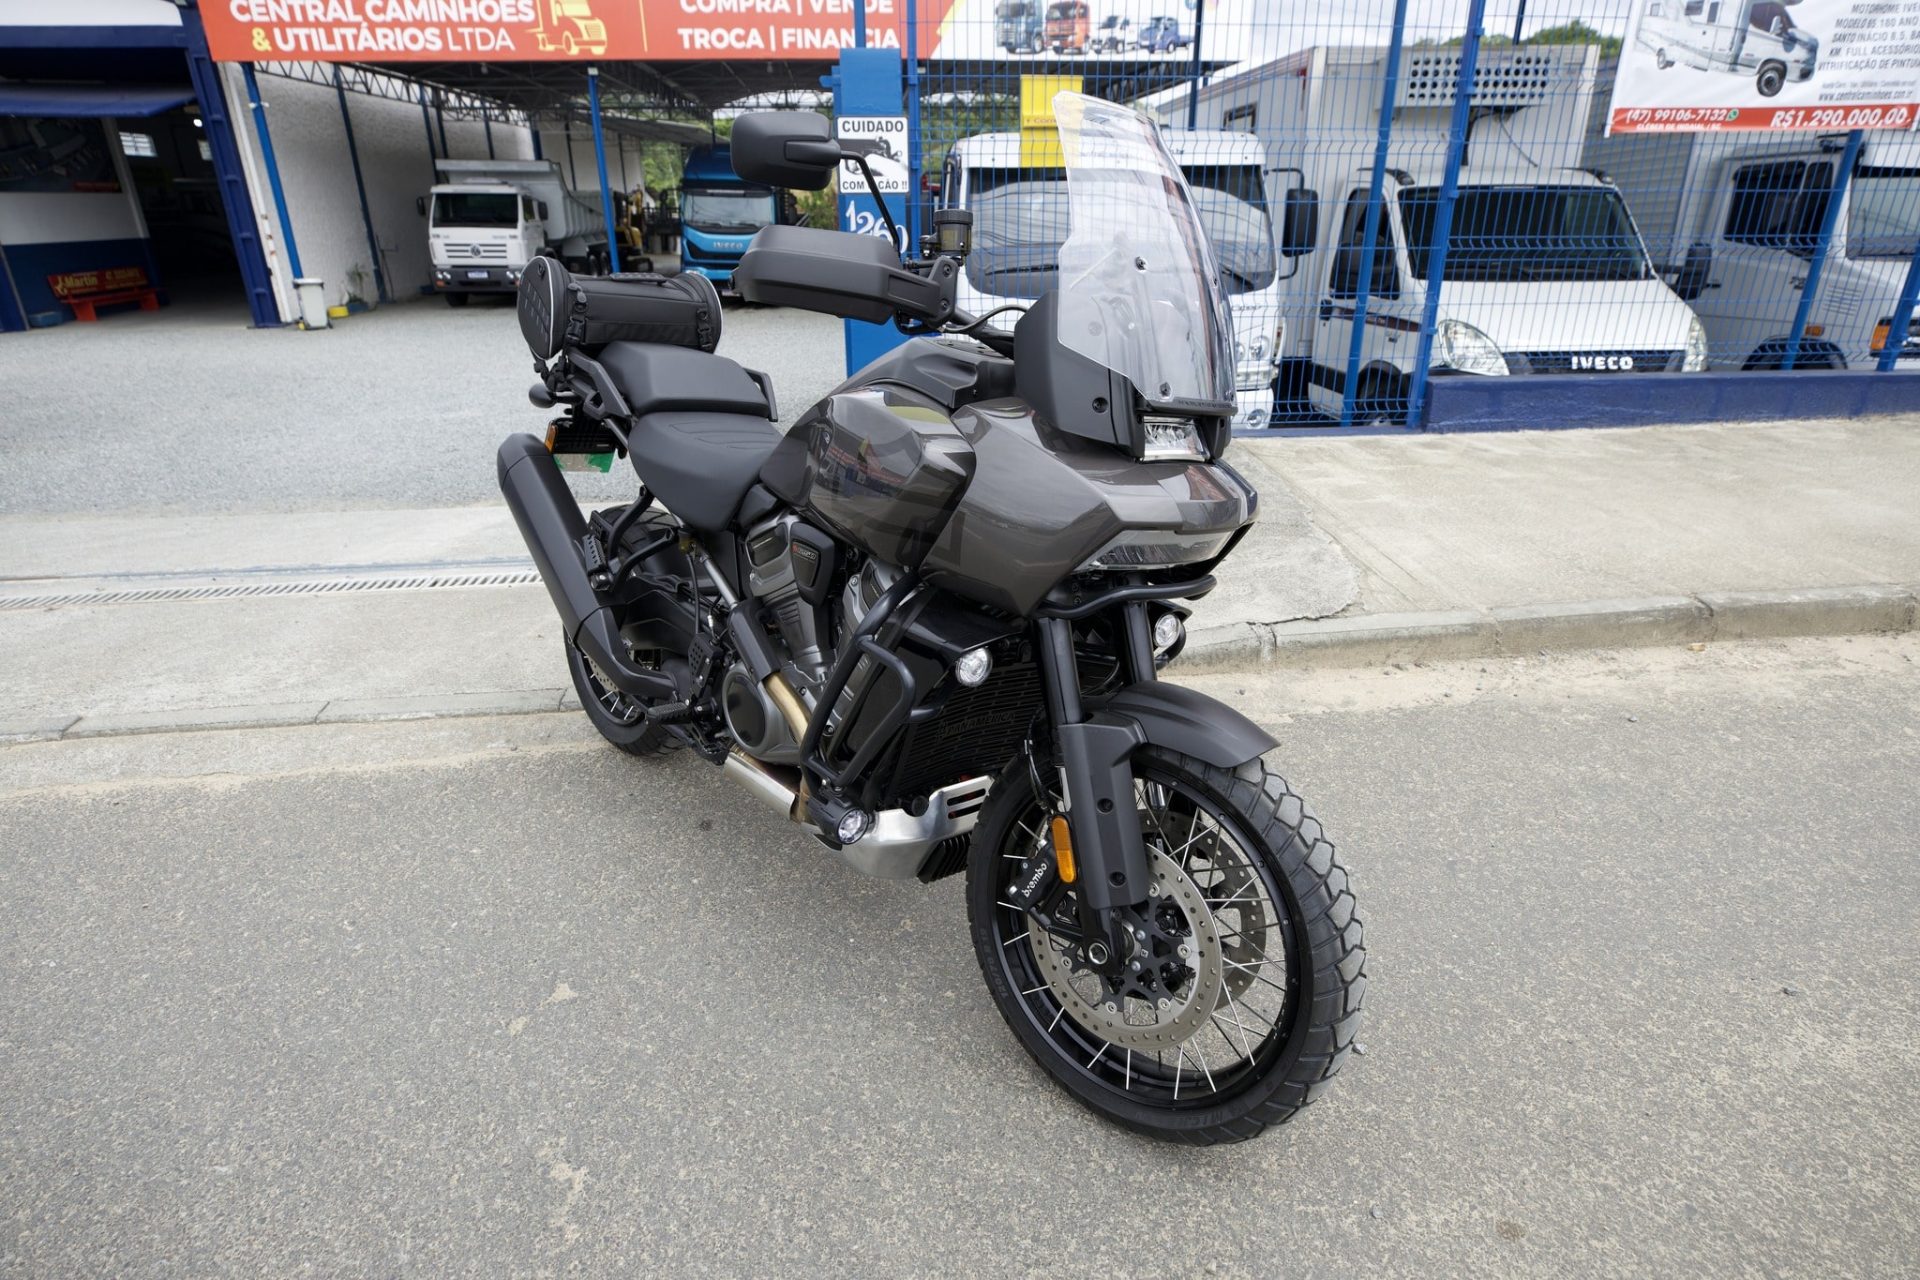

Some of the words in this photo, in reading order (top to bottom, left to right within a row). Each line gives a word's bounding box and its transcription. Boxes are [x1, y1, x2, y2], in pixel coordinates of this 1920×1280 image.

[229, 0, 363, 23] CENTRAL
[680, 0, 791, 14] COMPRA
[806, 0, 894, 14] VENDE
[1851, 3, 1901, 14] MOTORHOME
[1903, 2, 1920, 13] IVE
[1834, 19, 1867, 29] MODELO
[252, 28, 272, 52] &
[273, 23, 443, 52] UTILITÁRIOS
[448, 27, 515, 52] LTDA
[677, 27, 764, 49] TROCA
[1832, 32, 1857, 43] SANTO
[1845, 47, 1868, 57] FULL
[1878, 60, 1889, 69] DE
[1626, 109, 1652, 123] (47)
[1653, 108, 1727, 121] 99106-7132
[842, 120, 904, 133] CUIDADO
[842, 180, 865, 190] COM
[878, 179, 899, 190] CÃO
[713, 241, 744, 249] IVECO
[1571, 356, 1634, 370] IVECO
[1021, 863, 1048, 898] brembo
